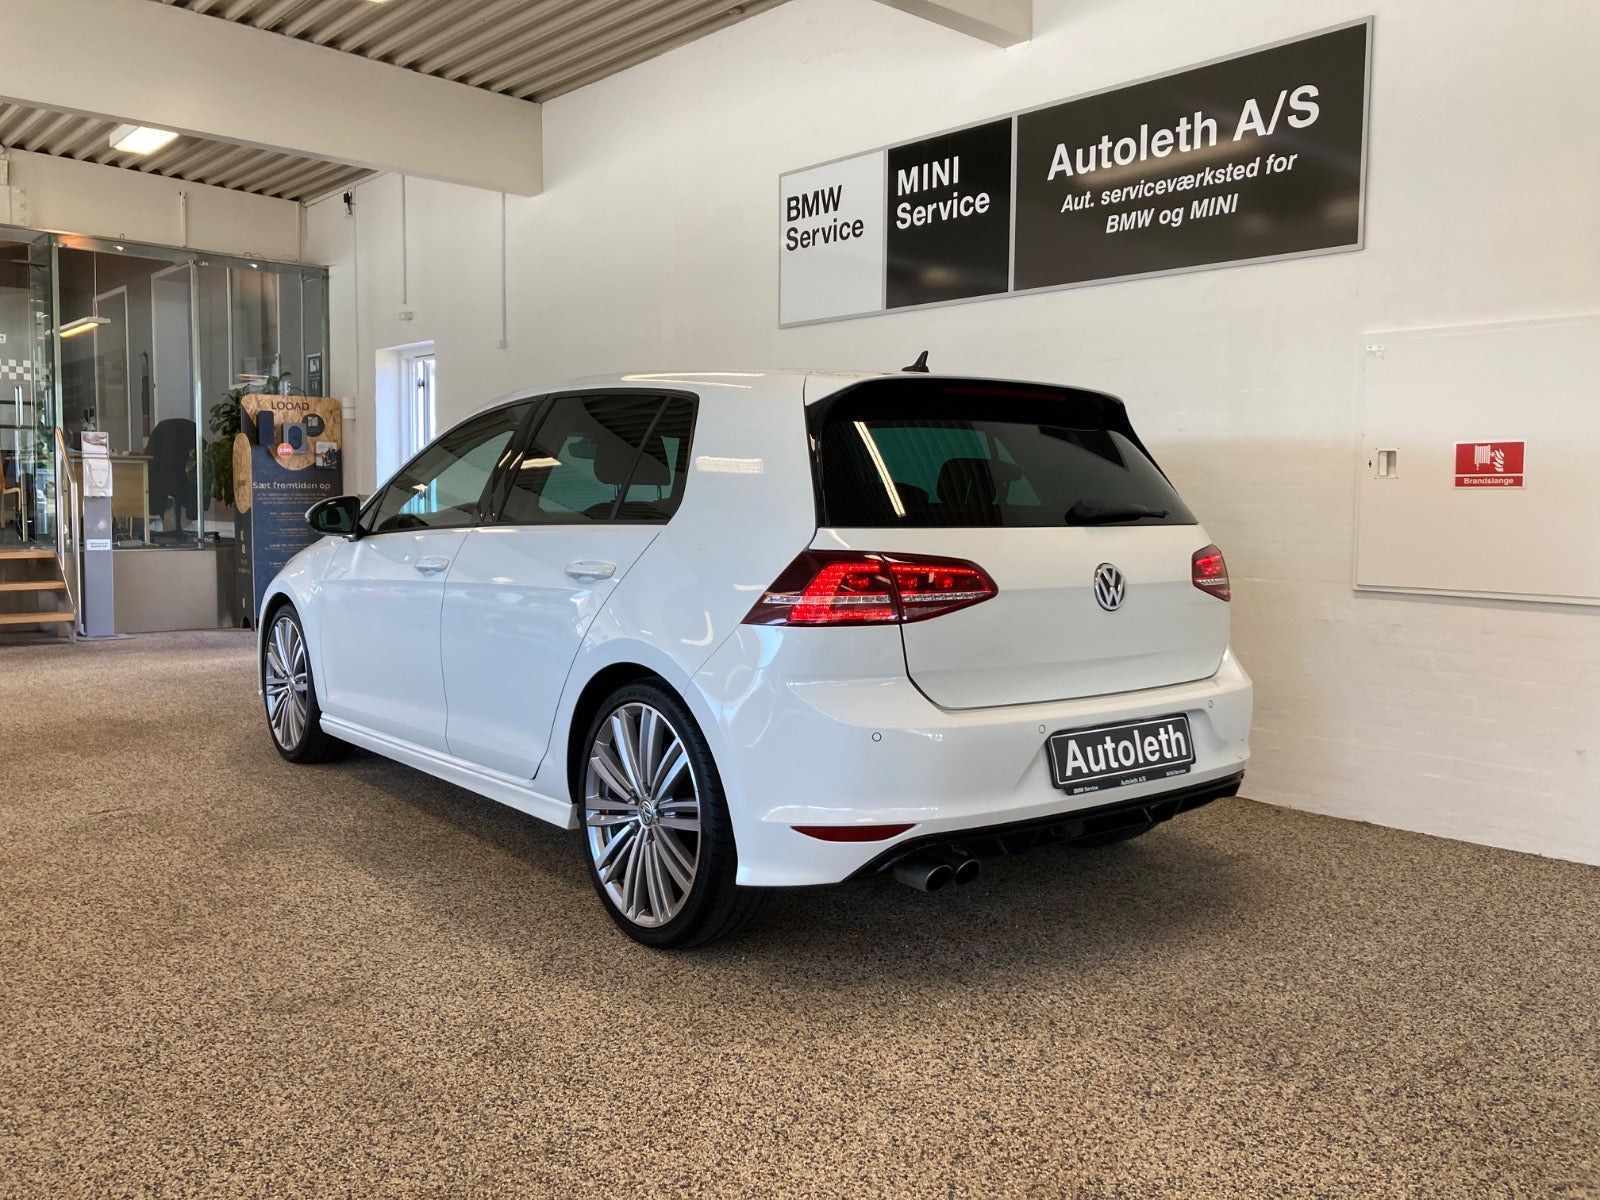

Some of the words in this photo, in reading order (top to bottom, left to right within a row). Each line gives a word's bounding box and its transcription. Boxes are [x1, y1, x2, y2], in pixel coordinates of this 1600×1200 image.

[1047, 111, 1217, 181] Autoleth
[1232, 85, 1320, 141] A/S
[897, 156, 960, 196] MINI
[1060, 192, 1095, 213] Aut.
[1101, 157, 1260, 206] serviceværksted
[1266, 153, 1298, 174] for
[786, 185, 842, 222] BMW
[896, 191, 991, 230] Service
[1105, 208, 1155, 233] BMW
[1158, 206, 1184, 227] og
[1190, 193, 1239, 220] MINI
[786, 218, 864, 252] Service
[319, 482, 331, 491] op
[1065, 725, 1187, 776] Autoleth
